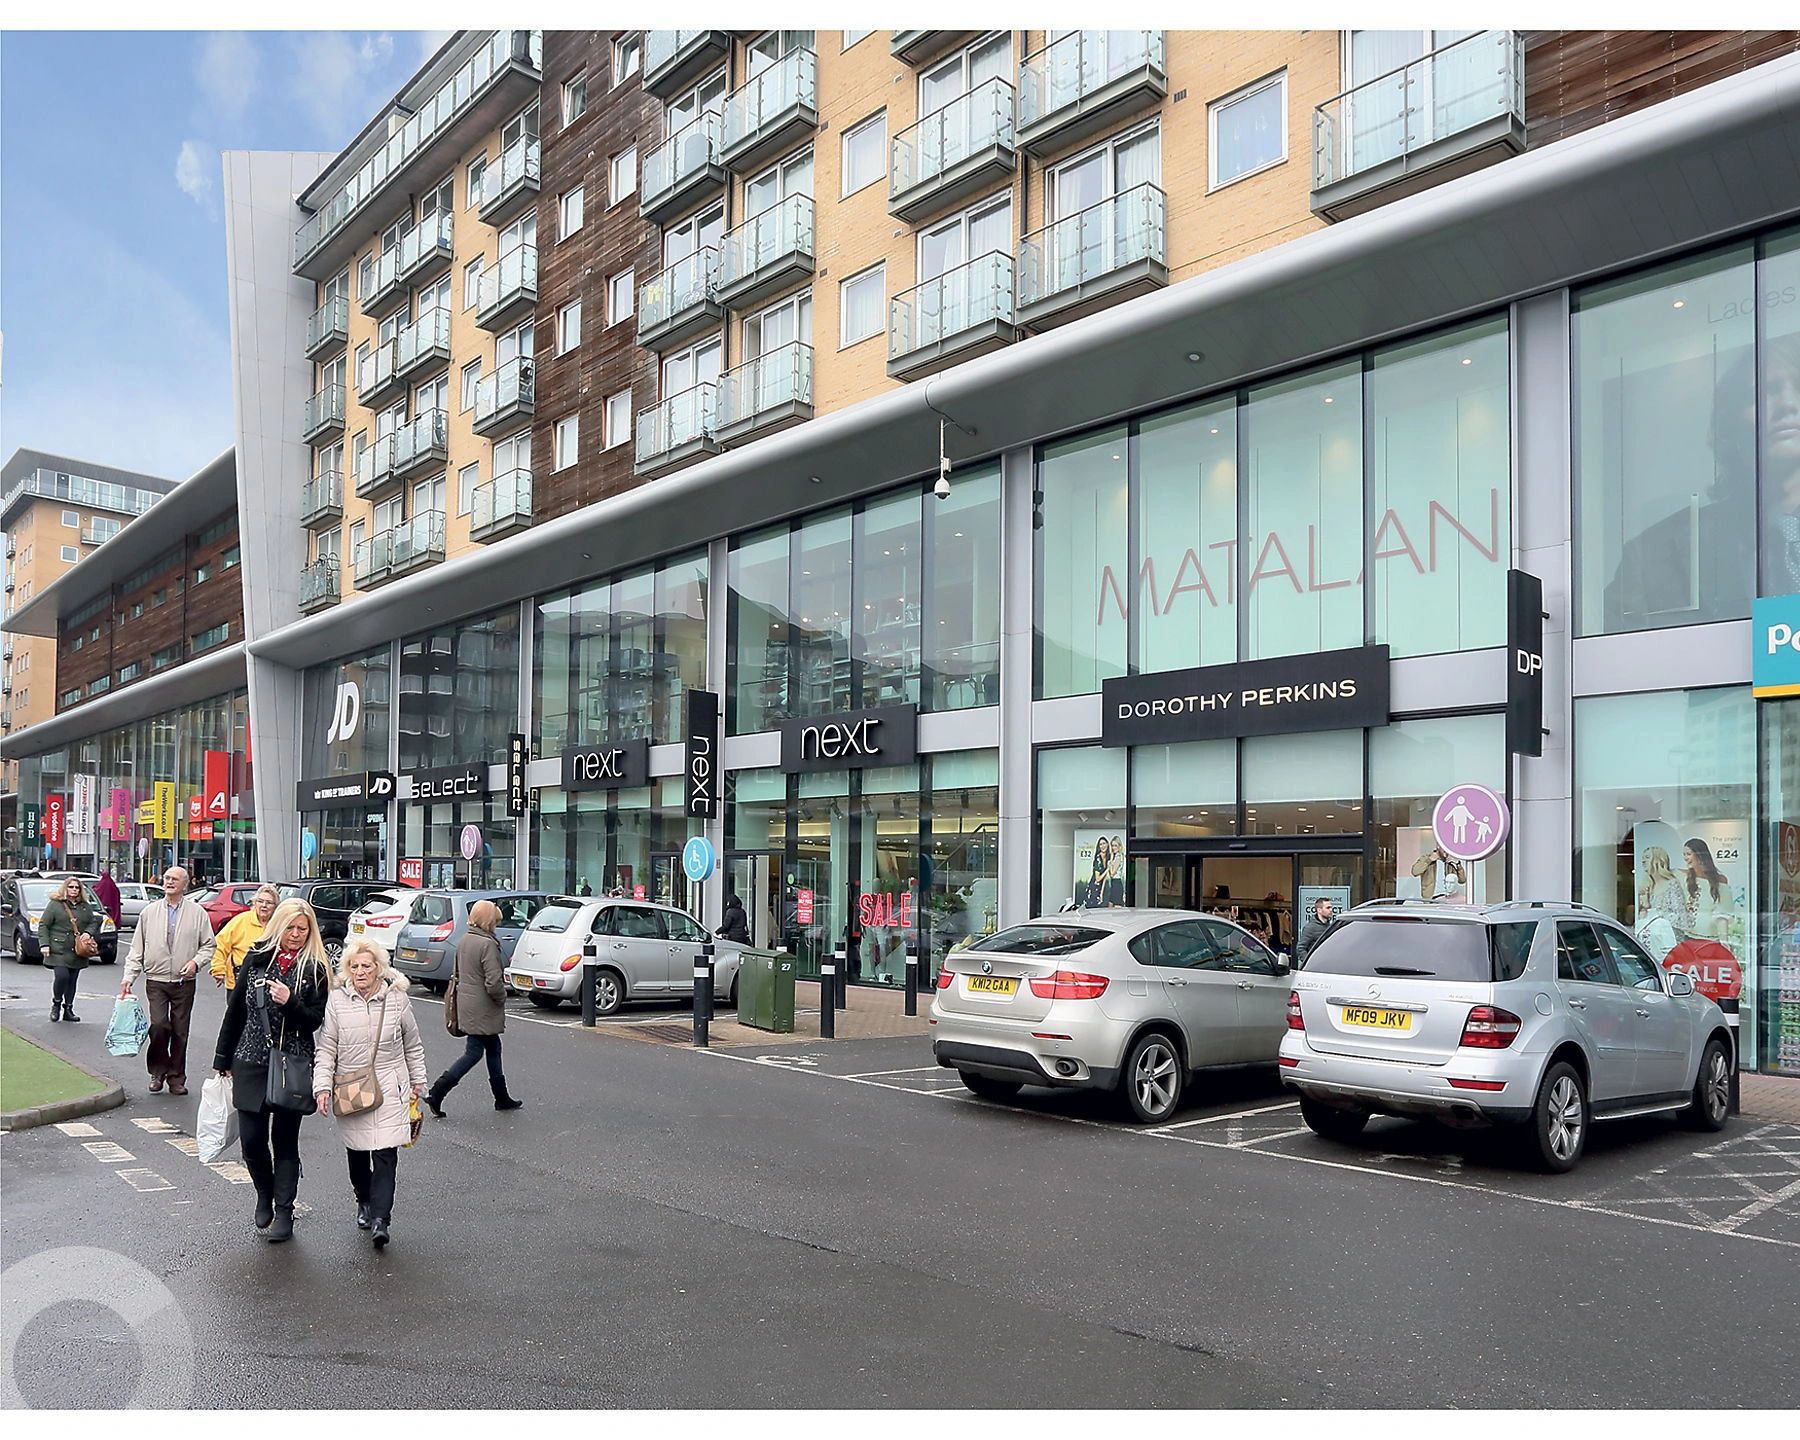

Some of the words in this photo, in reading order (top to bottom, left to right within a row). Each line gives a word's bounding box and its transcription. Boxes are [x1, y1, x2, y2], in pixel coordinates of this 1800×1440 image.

[1706, 286, 1796, 324] Lades
[1097, 488, 1499, 625] MATALAN
[1517, 650, 1543, 676] DP
[1118, 692, 1233, 719] DOROTHY
[1241, 679, 1358, 707] PERKINS
[327, 682, 360, 745] JD
[800, 717, 880, 759] next
[573, 748, 623, 781] next
[691, 735, 711, 813] next
[369, 777, 392, 794] JD
[1716, 849, 1739, 859] £24
[401, 862, 421, 879] SALE
[859, 892, 912, 928] SALE
[1305, 906, 1343, 914] COCT
[781, 963, 791, 971] 27
[1670, 963, 1732, 984] SALE
[992, 979, 1011, 992] GAA
[1346, 1008, 1377, 1023] MF09
[1379, 1013, 1406, 1026] JKV
